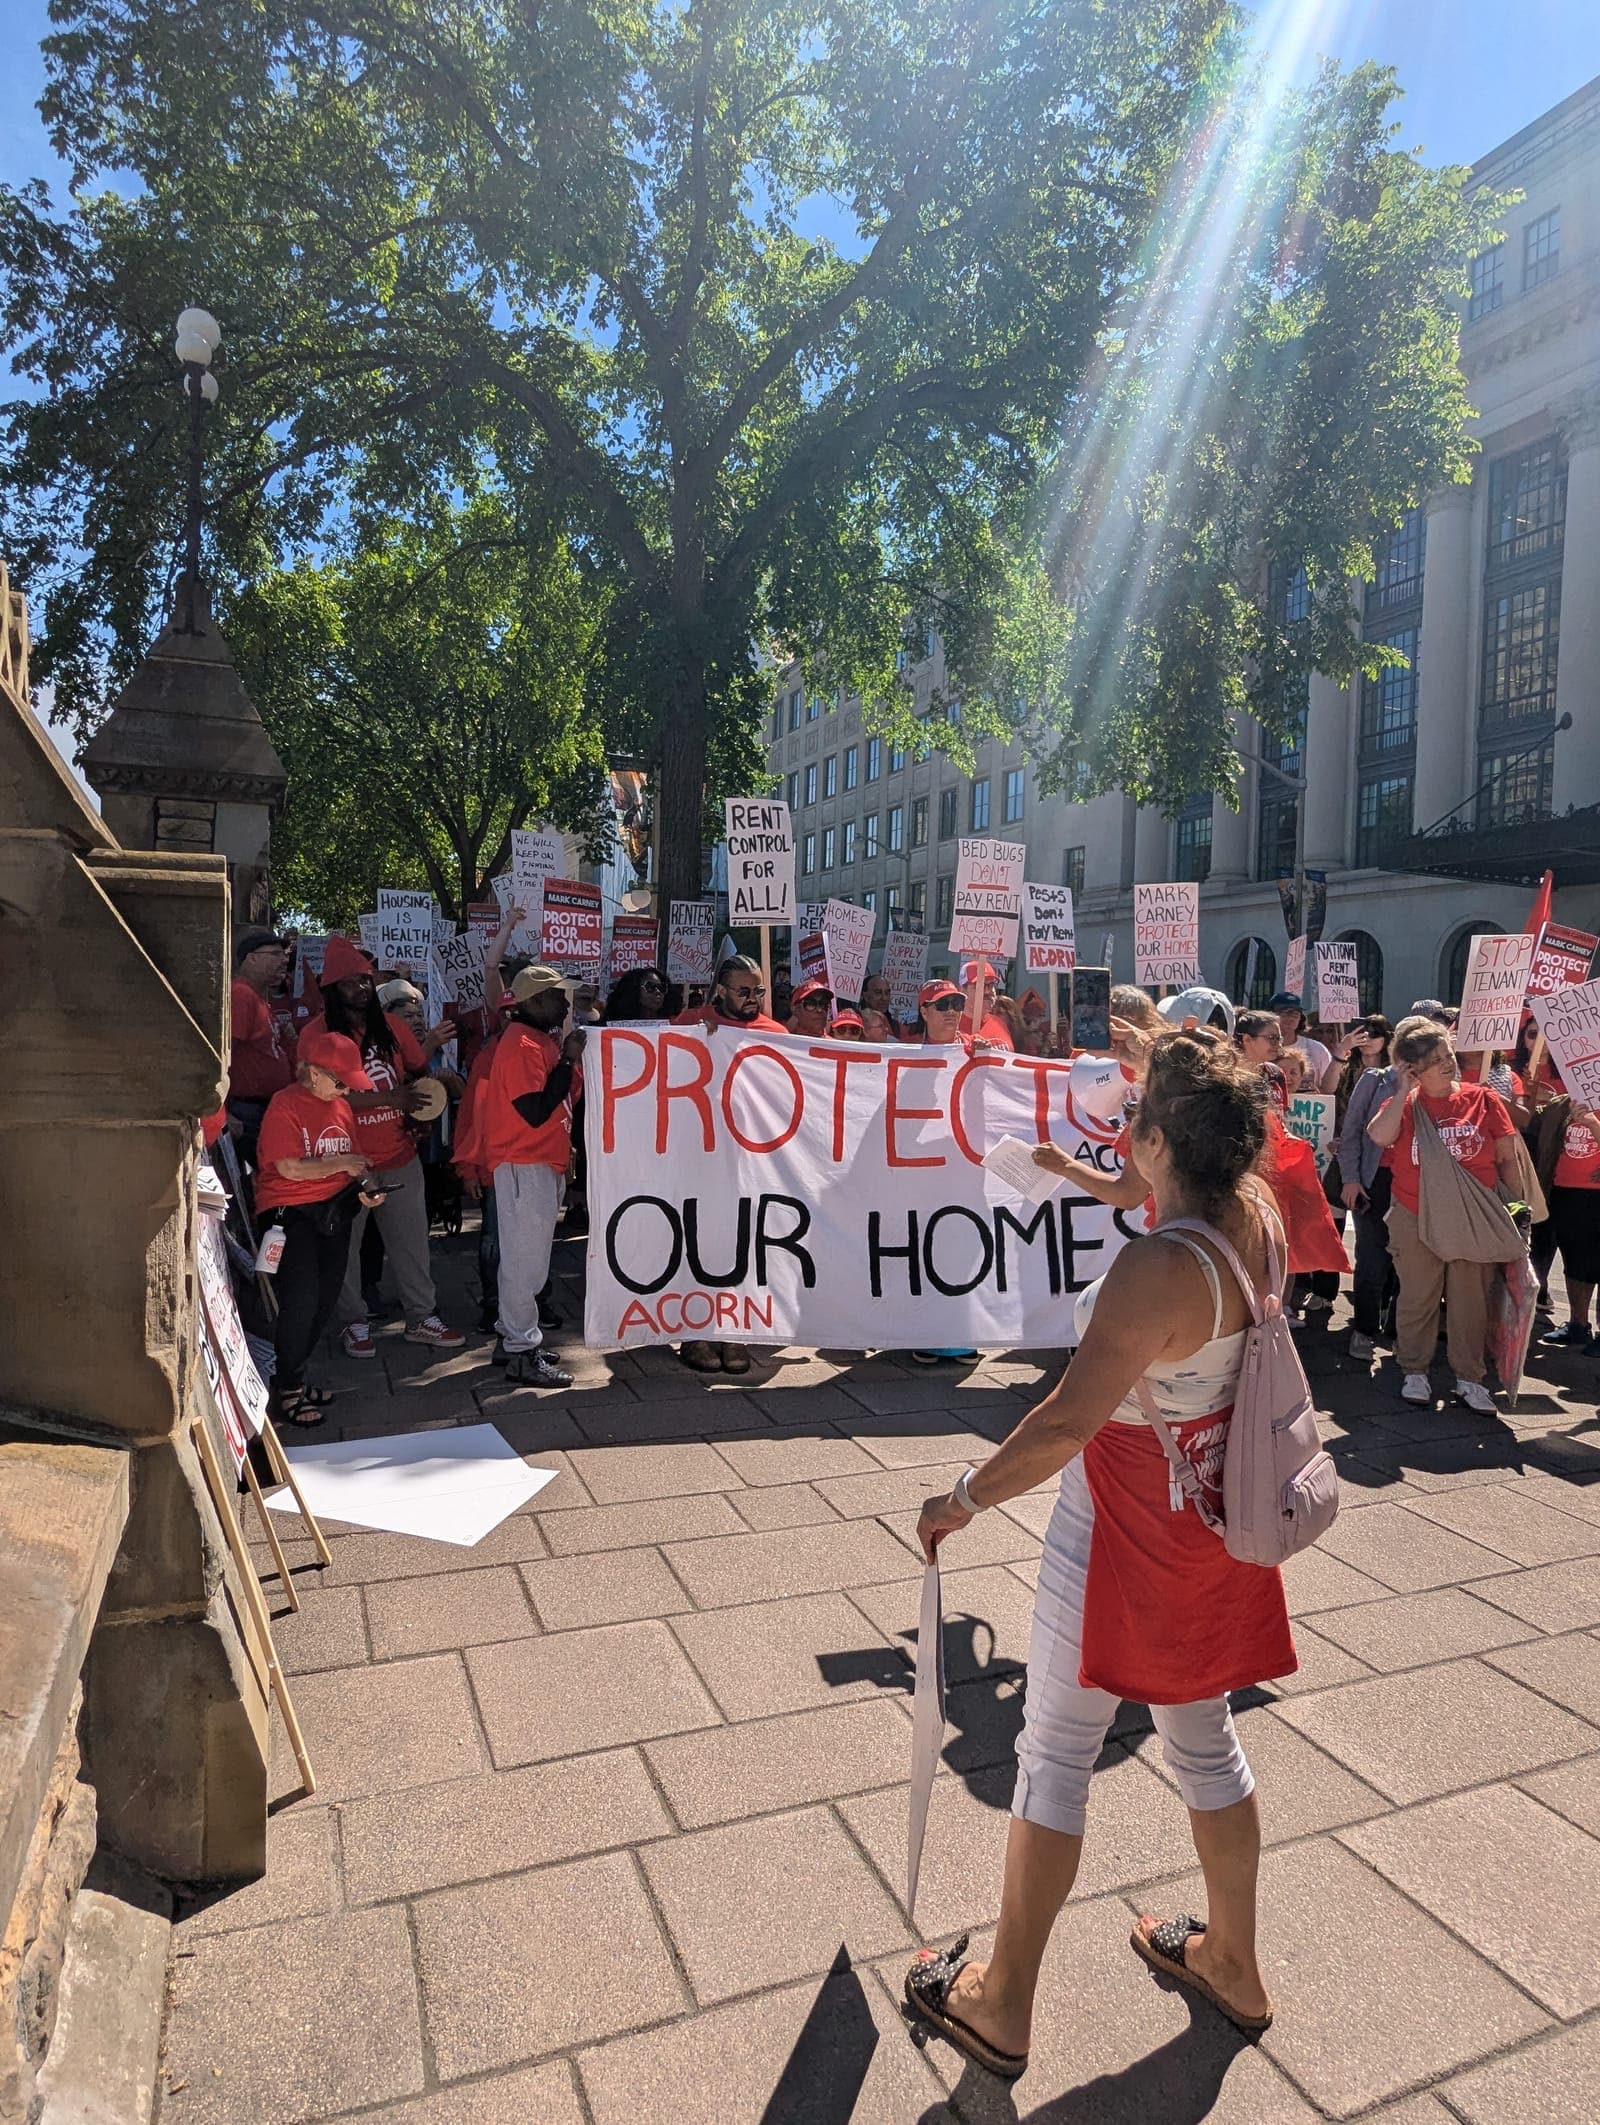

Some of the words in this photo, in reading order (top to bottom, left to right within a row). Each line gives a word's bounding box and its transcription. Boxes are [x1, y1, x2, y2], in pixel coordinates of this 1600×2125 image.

[732, 804, 783, 830] RENT
[515, 834, 529, 845] WE
[532, 836, 555, 848] WILL
[728, 833, 791, 856] CONTROL
[515, 849, 539, 860] KEEP
[541, 852, 554, 861] ON
[962, 840, 988, 859] BED
[993, 843, 1024, 862] BUGS
[743, 861, 774, 879] FOR
[971, 862, 1012, 885] DON'T
[381, 893, 430, 911] HOUSING
[548, 893, 570, 905] MARK
[571, 896, 600, 909] CARNEY
[735, 883, 788, 914] ALL!
[957, 891, 982, 909] PAY
[986, 893, 1020, 913] RENT
[1138, 886, 1190, 904] MARK
[396, 911, 412, 925] IS
[543, 910, 601, 928] PROTECT
[671, 903, 714, 926] RENTERS
[806, 904, 827, 917] FIX
[828, 903, 869, 928] HOMES
[1136, 904, 1195, 924] CARNEY
[381, 925, 430, 943] HEALTH
[549, 925, 578, 939] OUR
[673, 926, 697, 936] ARE
[824, 922, 846, 942] ARE
[848, 930, 871, 948] NOT
[958, 918, 1006, 936] ACORN
[1137, 923, 1199, 941] PROTECT
[437, 935, 468, 960] BAN
[542, 937, 601, 956] HOMES
[613, 940, 656, 951] PROTECT
[892, 933, 928, 946] HOUSING
[962, 935, 1003, 953] DOES!
[1136, 940, 1161, 956] OUR
[1164, 940, 1197, 955] HOMES
[1545, 937, 1566, 950] MARK
[1566, 943, 1592, 957] CARNEY
[385, 944, 428, 962] CARE!
[616, 950, 638, 960] OUR
[829, 943, 864, 970] SSETS
[888, 945, 923, 959] SUPPLY
[1029, 947, 1076, 968] ACORN
[1317, 943, 1357, 960] NATIONAL
[1478, 935, 1532, 967] STOP
[611, 959, 656, 972] HOMES
[900, 959, 921, 968] ONLY
[1329, 961, 1350, 975] RENT
[1536, 951, 1589, 974] PROTECT
[455, 969, 484, 990] BAN
[883, 967, 903, 980] HALF
[906, 970, 924, 981] THE
[1143, 962, 1196, 982] ACORN
[1322, 973, 1357, 989] CONTROL
[1471, 968, 1528, 992] TENANT
[1539, 964, 1566, 980] OUR
[1332, 988, 1345, 997] NO
[1544, 981, 1599, 1017] RENT
[1323, 1004, 1357, 1020] ACORN
[1466, 994, 1524, 1014] DISPLACEMENT
[1464, 1015, 1517, 1045] ACORN
[1560, 1036, 1598, 1061] FOR
[1095, 1072, 1110, 1085] PYLE
[601, 1030, 1072, 1168] PROTECT
[606, 1194, 816, 1294] OUR
[618, 1292, 773, 1340] ACORN
